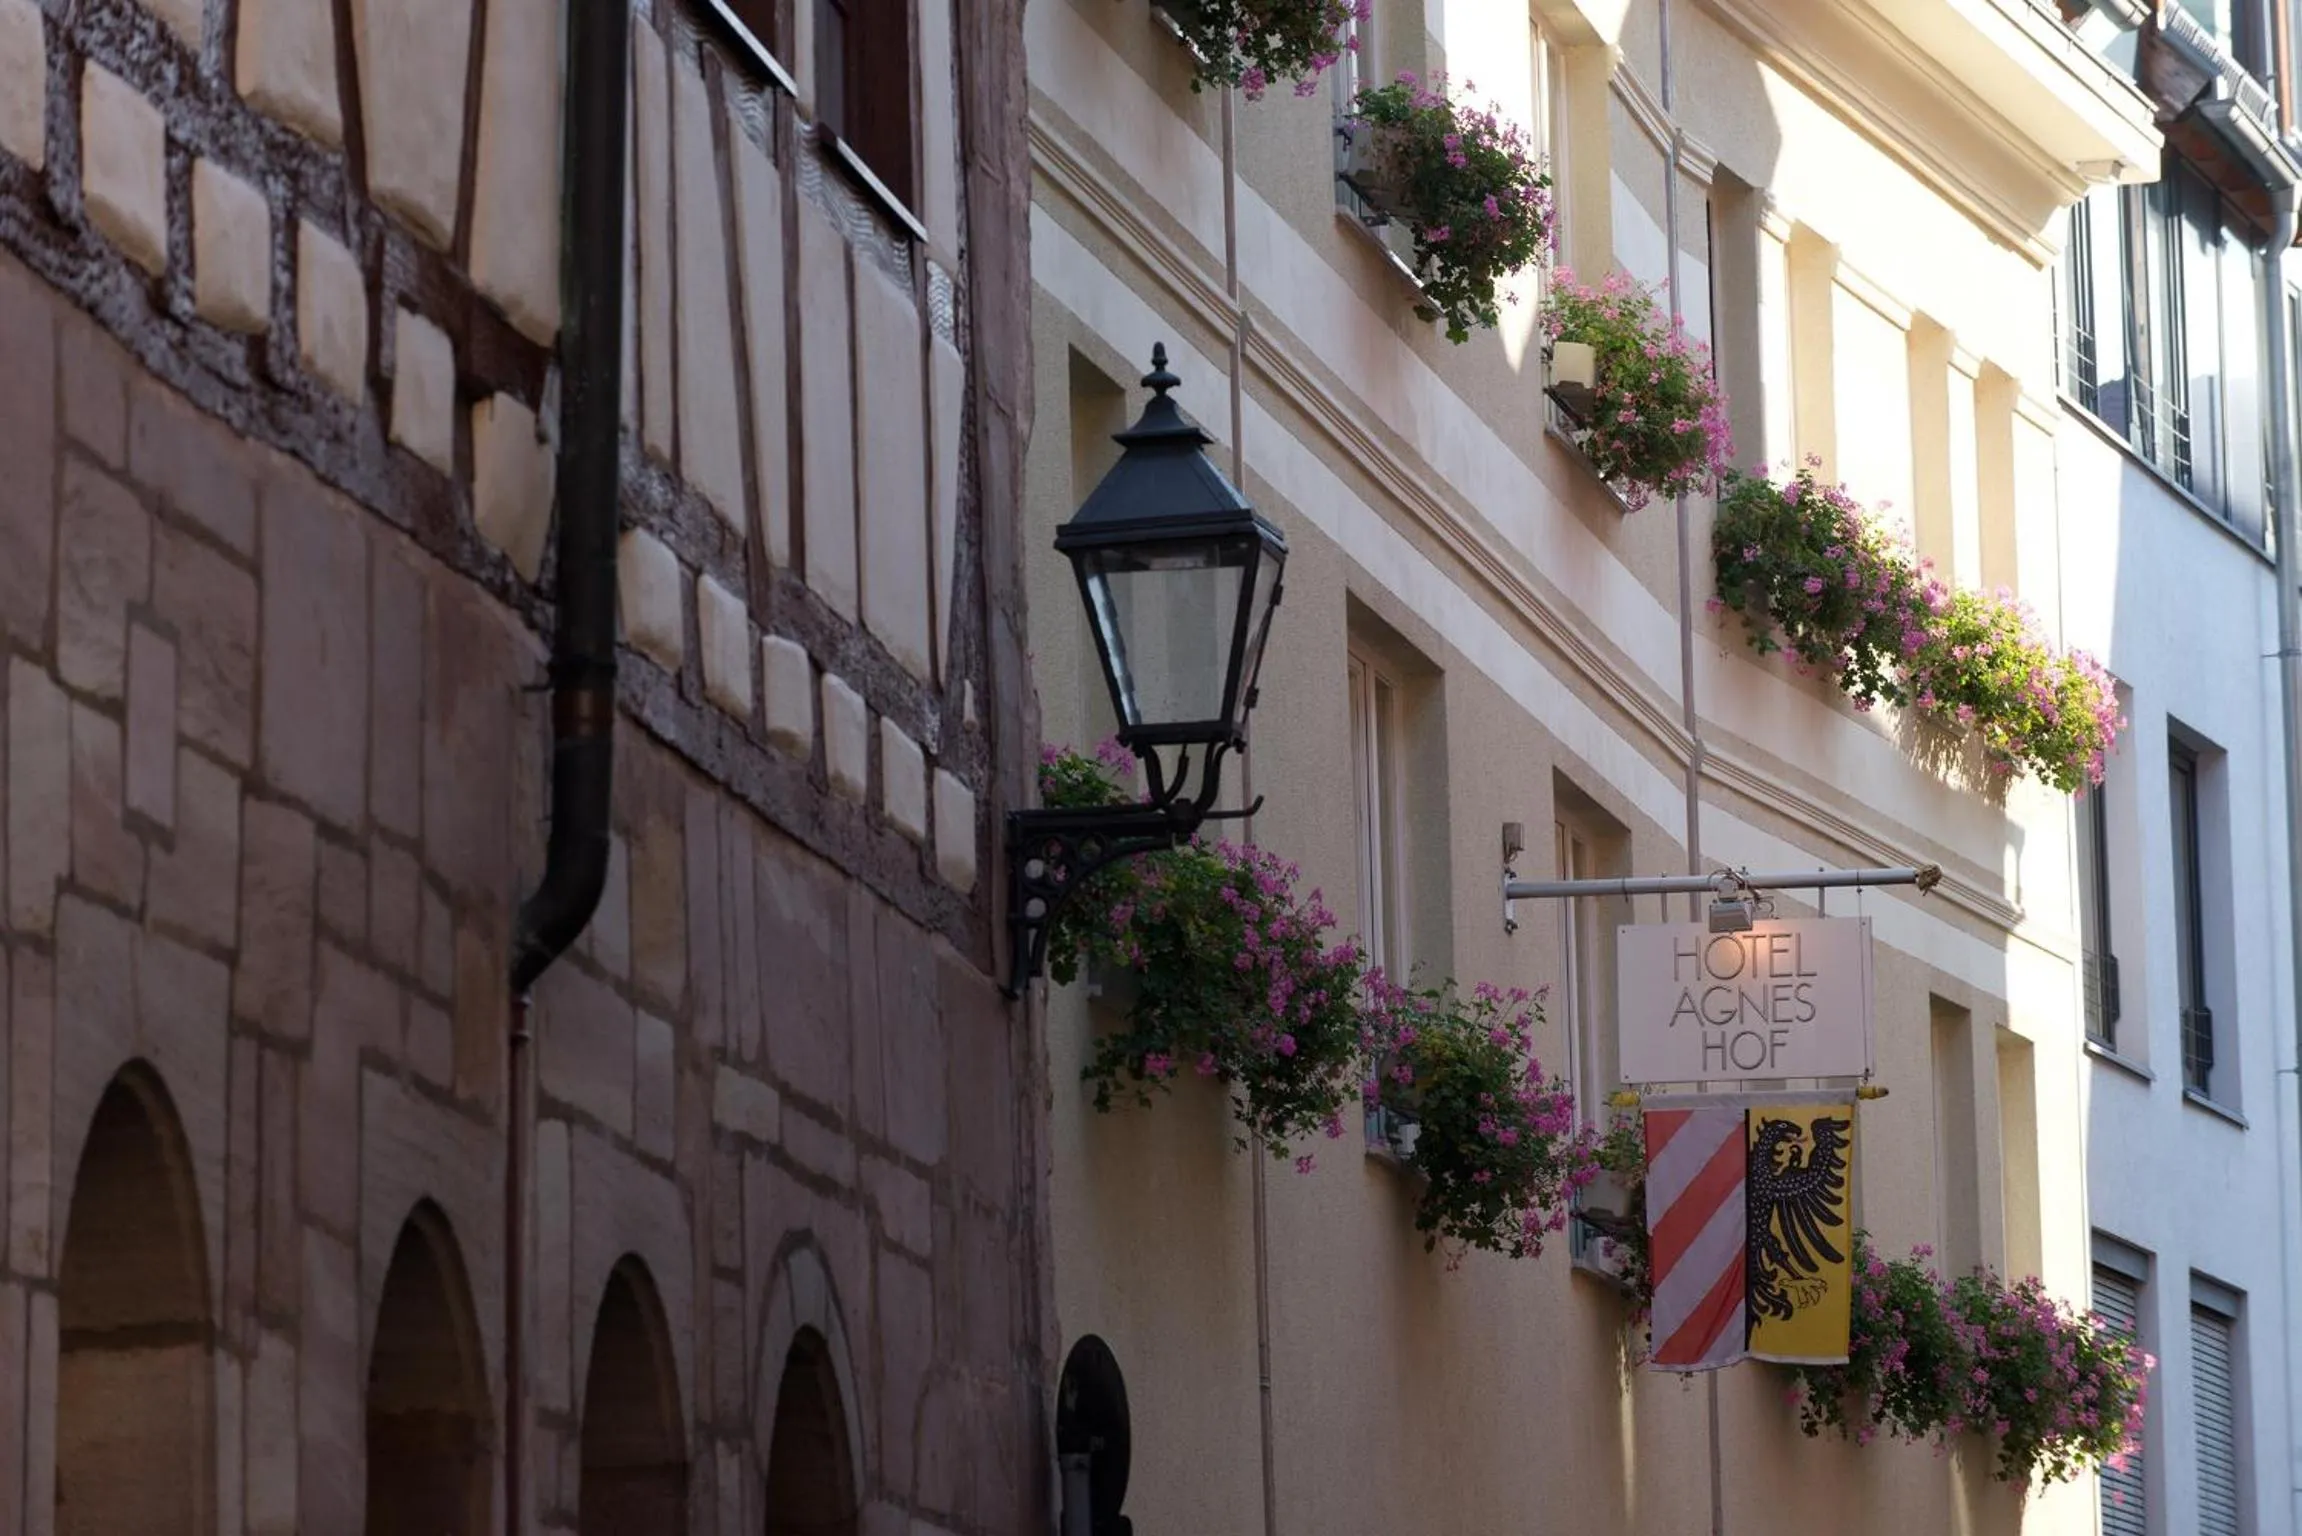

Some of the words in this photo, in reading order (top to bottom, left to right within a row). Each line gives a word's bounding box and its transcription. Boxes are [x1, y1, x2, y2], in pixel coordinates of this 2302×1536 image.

[1673, 932, 1817, 981] HOTEL
[1669, 983, 1816, 1027] AGNES
[1702, 1029, 1789, 1071] HOF
